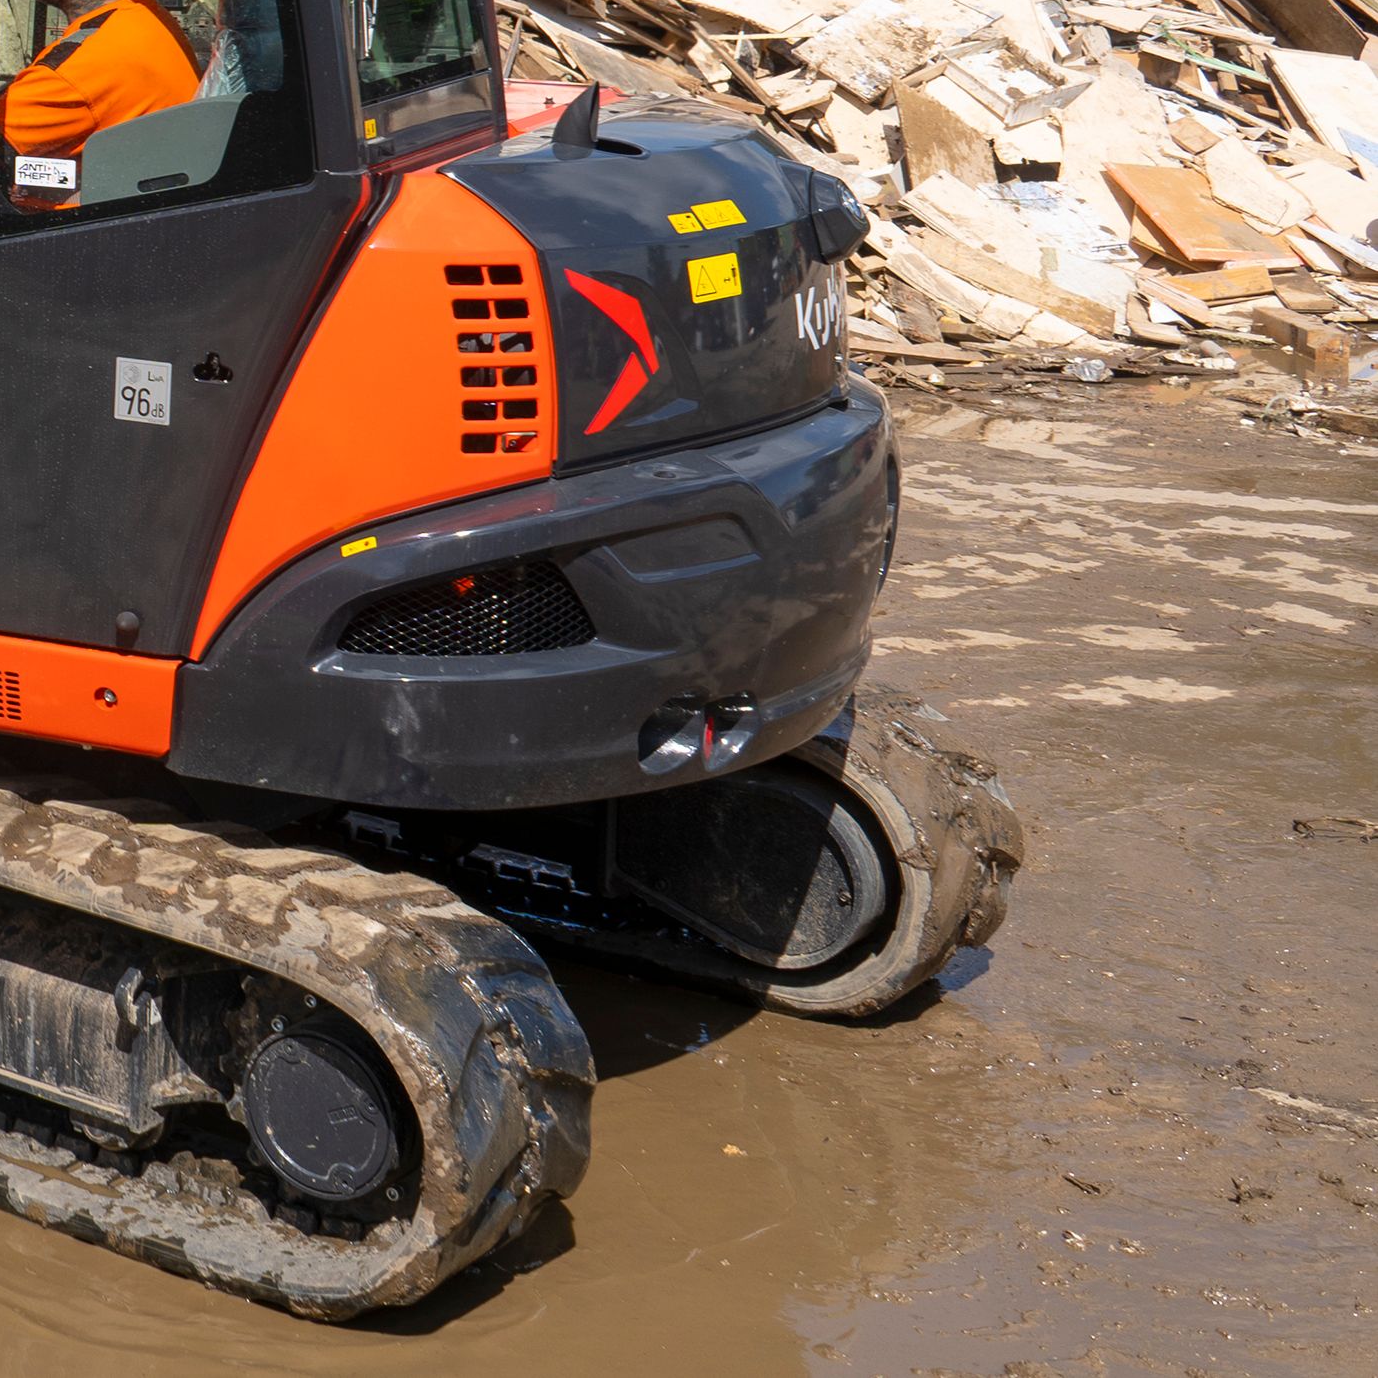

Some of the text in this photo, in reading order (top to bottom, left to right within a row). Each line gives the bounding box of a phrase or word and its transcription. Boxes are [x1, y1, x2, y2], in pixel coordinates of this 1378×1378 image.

[17, 171, 52, 181] THEFT
[121, 386, 165, 419] 96 dB
